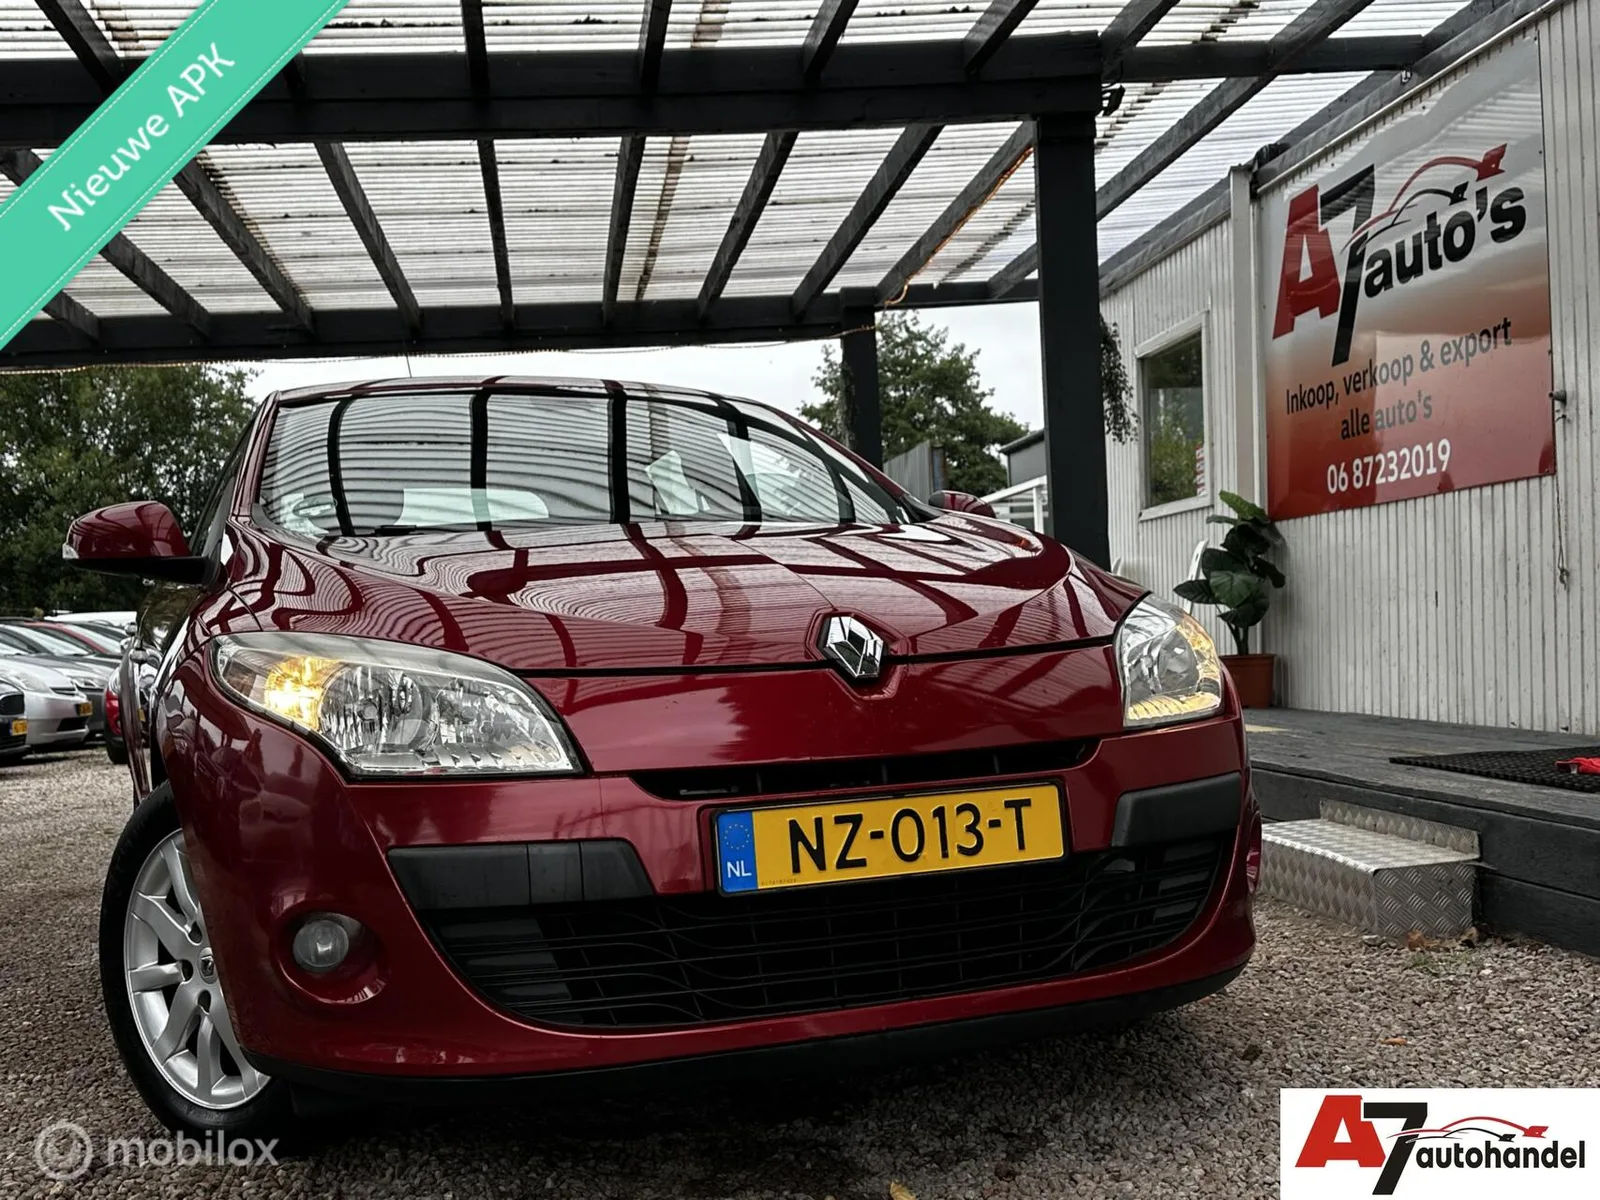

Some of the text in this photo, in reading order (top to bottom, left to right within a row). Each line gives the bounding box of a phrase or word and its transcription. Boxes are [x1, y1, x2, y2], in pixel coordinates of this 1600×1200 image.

[1272, 163, 1376, 368] A7
[1363, 186, 1528, 299] auto's
[1286, 316, 1513, 415] Inkoop, verkoop & export
[1340, 389, 1433, 441] alle auto's
[1326, 438, 1452, 495] 06 87232019
[726, 859, 752, 879] NL
[787, 797, 1032, 875] NZ-013-T
